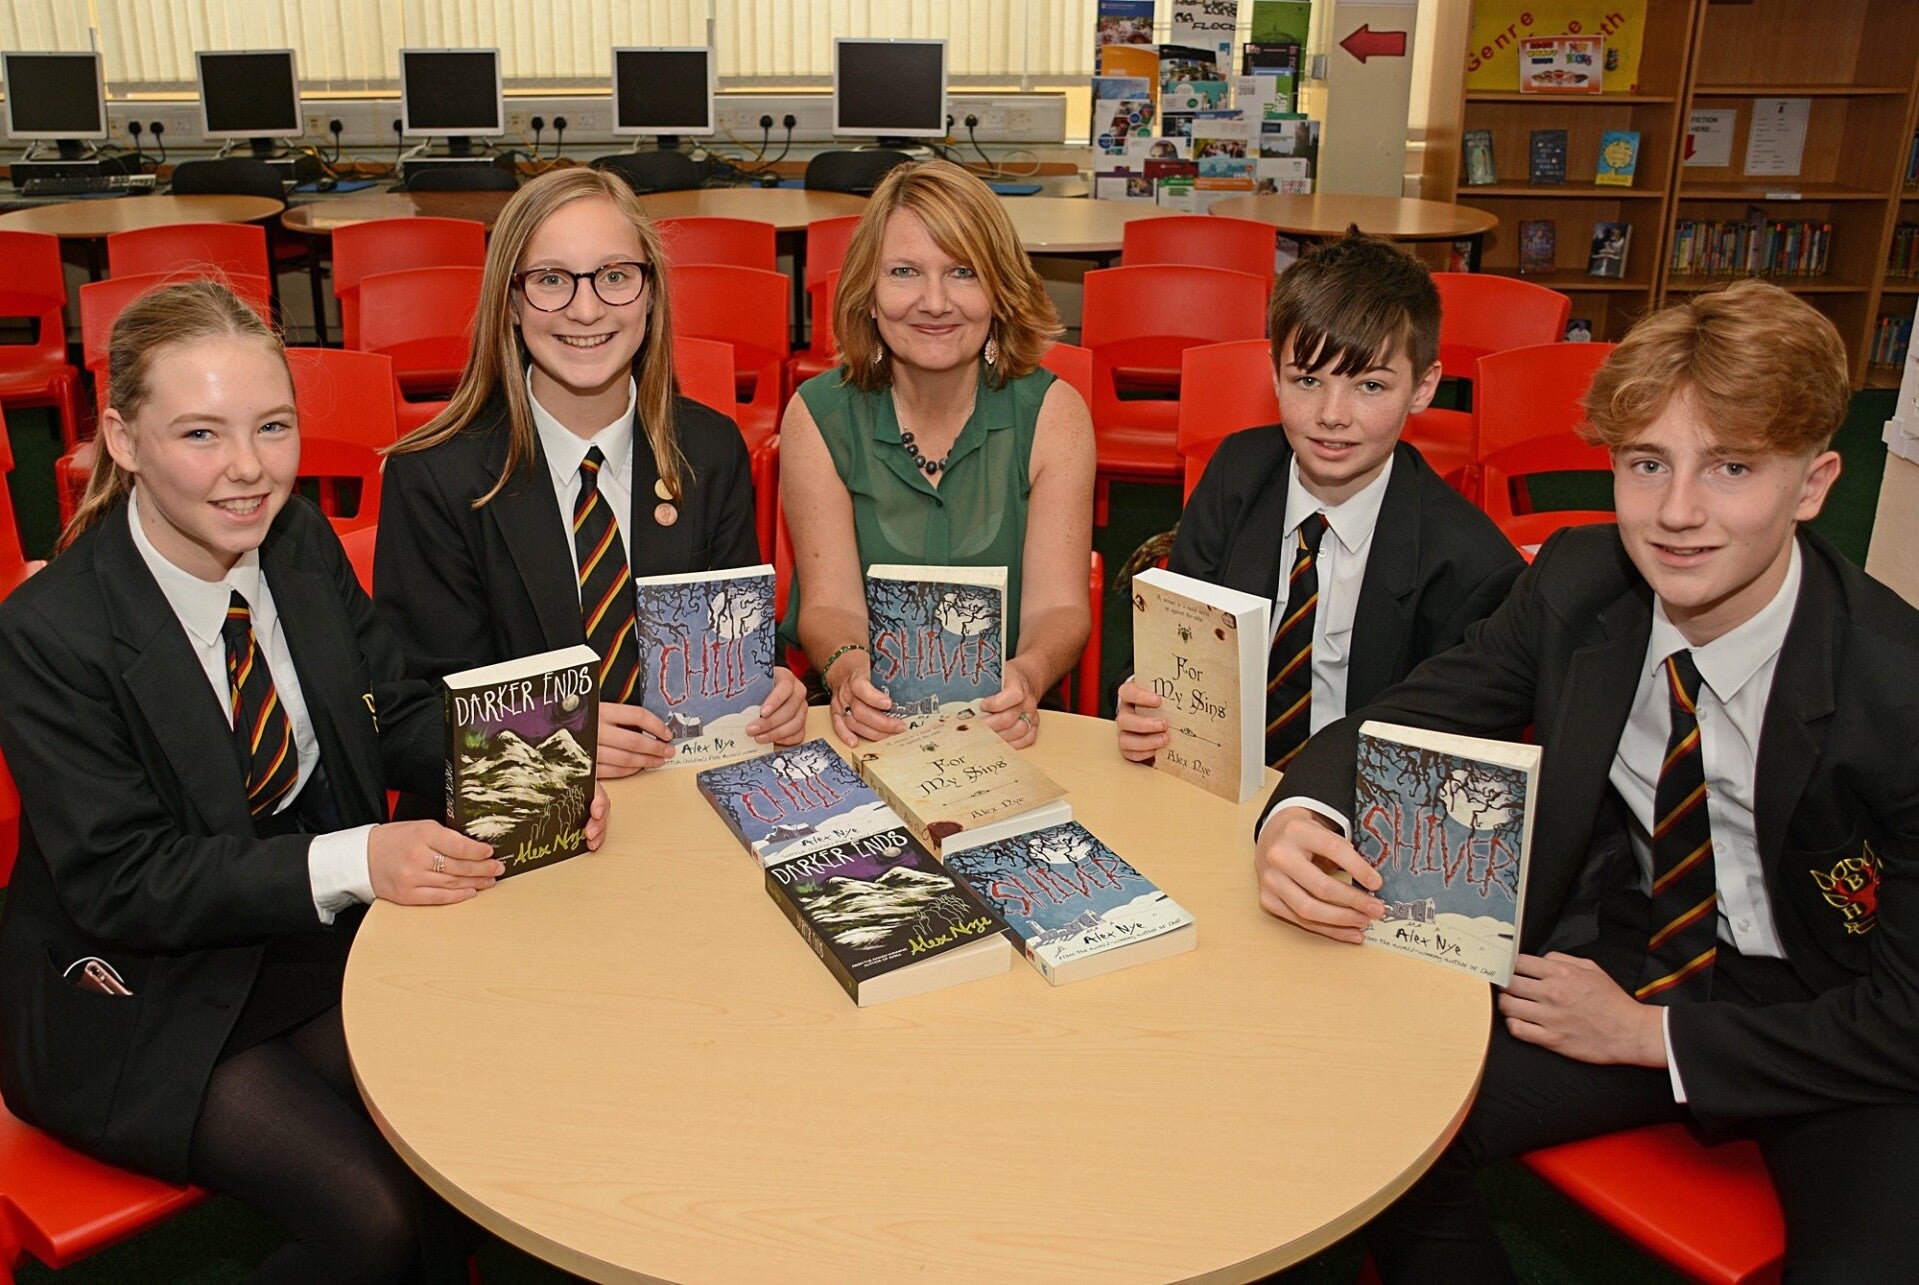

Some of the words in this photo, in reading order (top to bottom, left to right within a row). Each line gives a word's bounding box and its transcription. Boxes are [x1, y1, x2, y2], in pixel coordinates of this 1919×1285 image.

[1467, 11, 1534, 72] Genre
[660, 634, 759, 707] CHILL
[874, 627, 999, 686] SHIVER
[1172, 652, 1204, 681] For
[455, 680, 535, 727] DARKER
[543, 665, 593, 706] ENDS
[1151, 677, 1183, 711] My
[1189, 688, 1227, 722] Sins
[682, 741, 711, 755] Alex
[714, 737, 736, 754] Nye
[1166, 748, 1188, 768] Alex
[1193, 759, 1212, 779] Nye
[916, 777, 962, 798] My
[962, 755, 1008, 784] Sins
[925, 755, 966, 776] For
[741, 771, 851, 823] CHILL
[971, 806, 998, 819] Alex
[513, 839, 551, 866] Alex
[801, 834, 831, 847] Alex
[833, 828, 858, 839] Nye
[1359, 802, 1514, 901] SHIVER
[770, 847, 855, 885] DARKER
[850, 830, 909, 858] ENDS
[990, 855, 1144, 917] SHIVER
[1845, 873, 1864, 892] B
[1842, 902, 1862, 920] H
[907, 934, 953, 956] Alex
[949, 916, 992, 939] Nye
[1083, 930, 1116, 945] Alex
[1115, 922, 1146, 935] Nye
[1395, 928, 1431, 948] Alex
[1435, 934, 1462, 957] Nye
